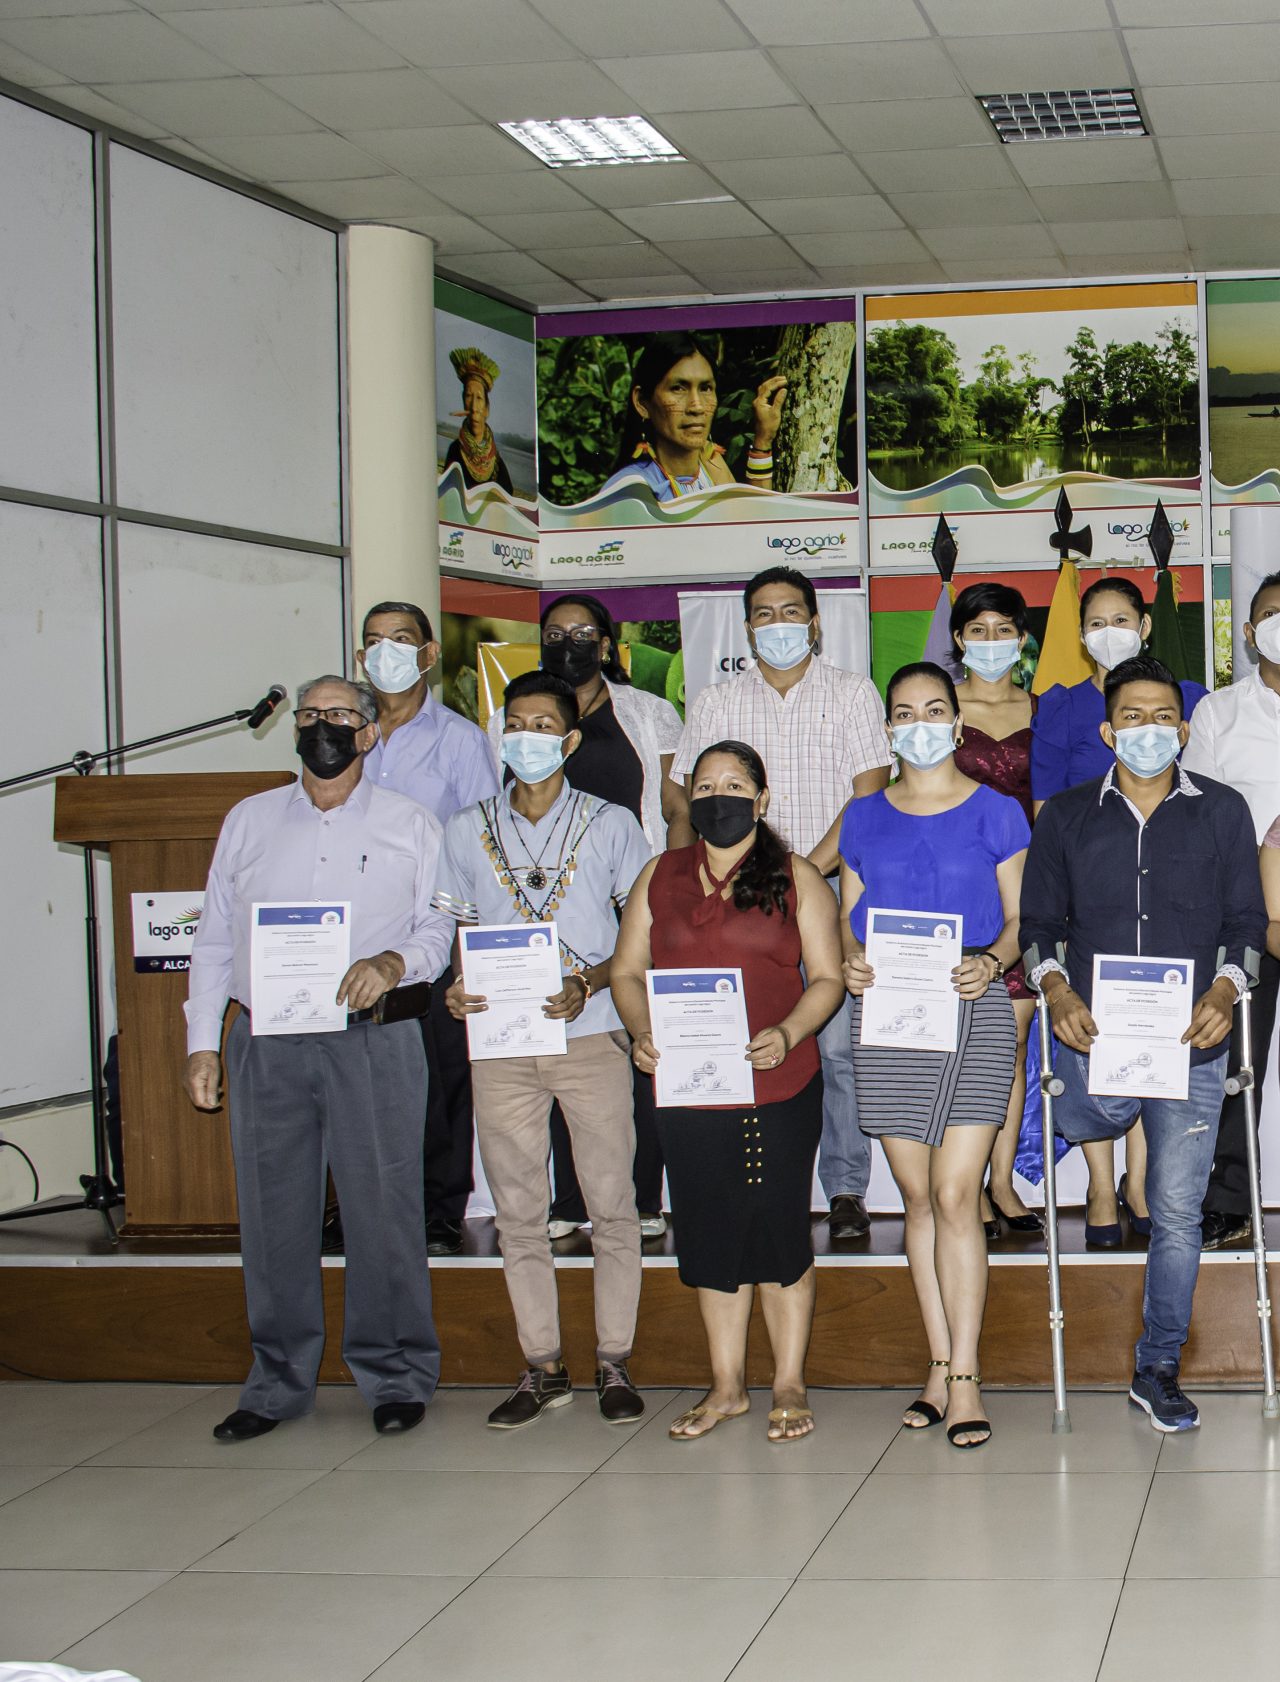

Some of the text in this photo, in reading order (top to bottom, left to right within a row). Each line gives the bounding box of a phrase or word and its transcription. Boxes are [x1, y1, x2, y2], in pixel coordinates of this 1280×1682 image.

[1107, 522, 1143, 537] Lago
[767, 534, 840, 551] Lago agrio
[881, 542, 916, 550] LAGO
[550, 556, 583, 565] LAGO
[586, 554, 625, 563] AGRIO
[148, 921, 180, 941] lago
[163, 960, 191, 970] ALCA
